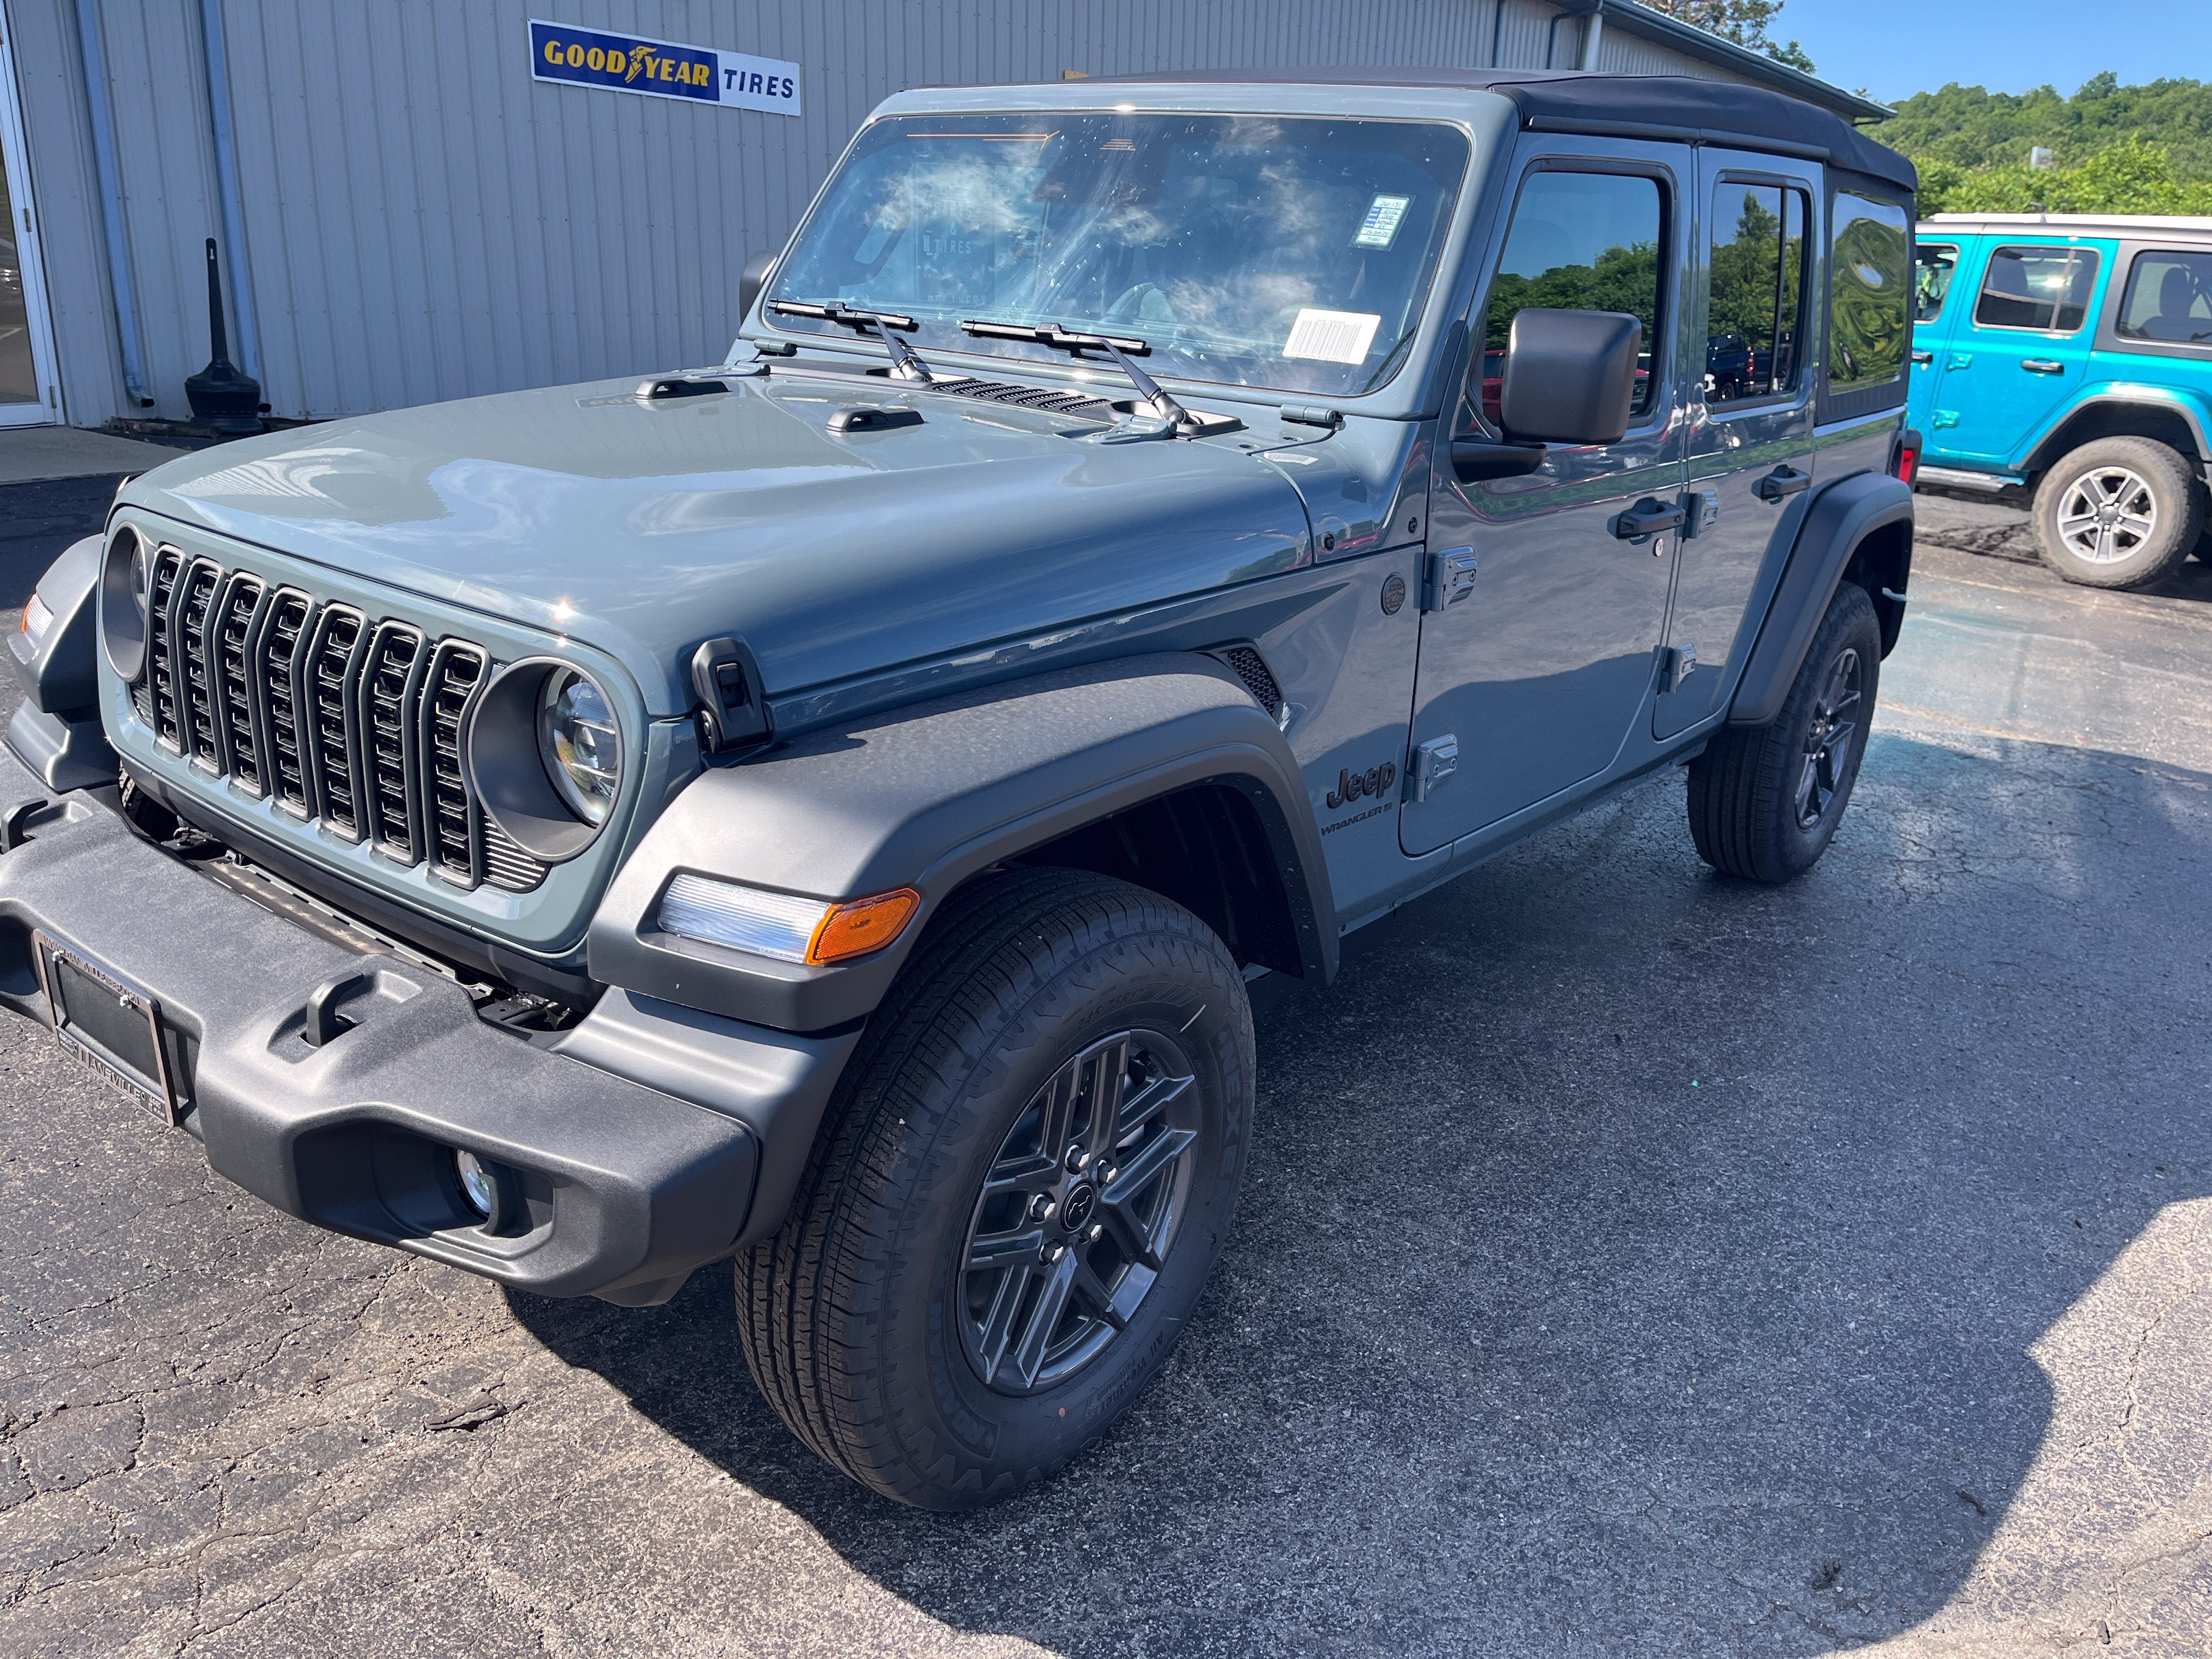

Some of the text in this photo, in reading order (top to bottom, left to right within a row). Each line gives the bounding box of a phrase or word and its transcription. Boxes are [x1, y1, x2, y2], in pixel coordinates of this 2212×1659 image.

[544, 40, 794, 99] GOODYEAR TIRES
[934, 239, 971, 254] TIRES
[1327, 761, 1396, 809] Jeep
[1321, 806, 1382, 836] WRANGLER
